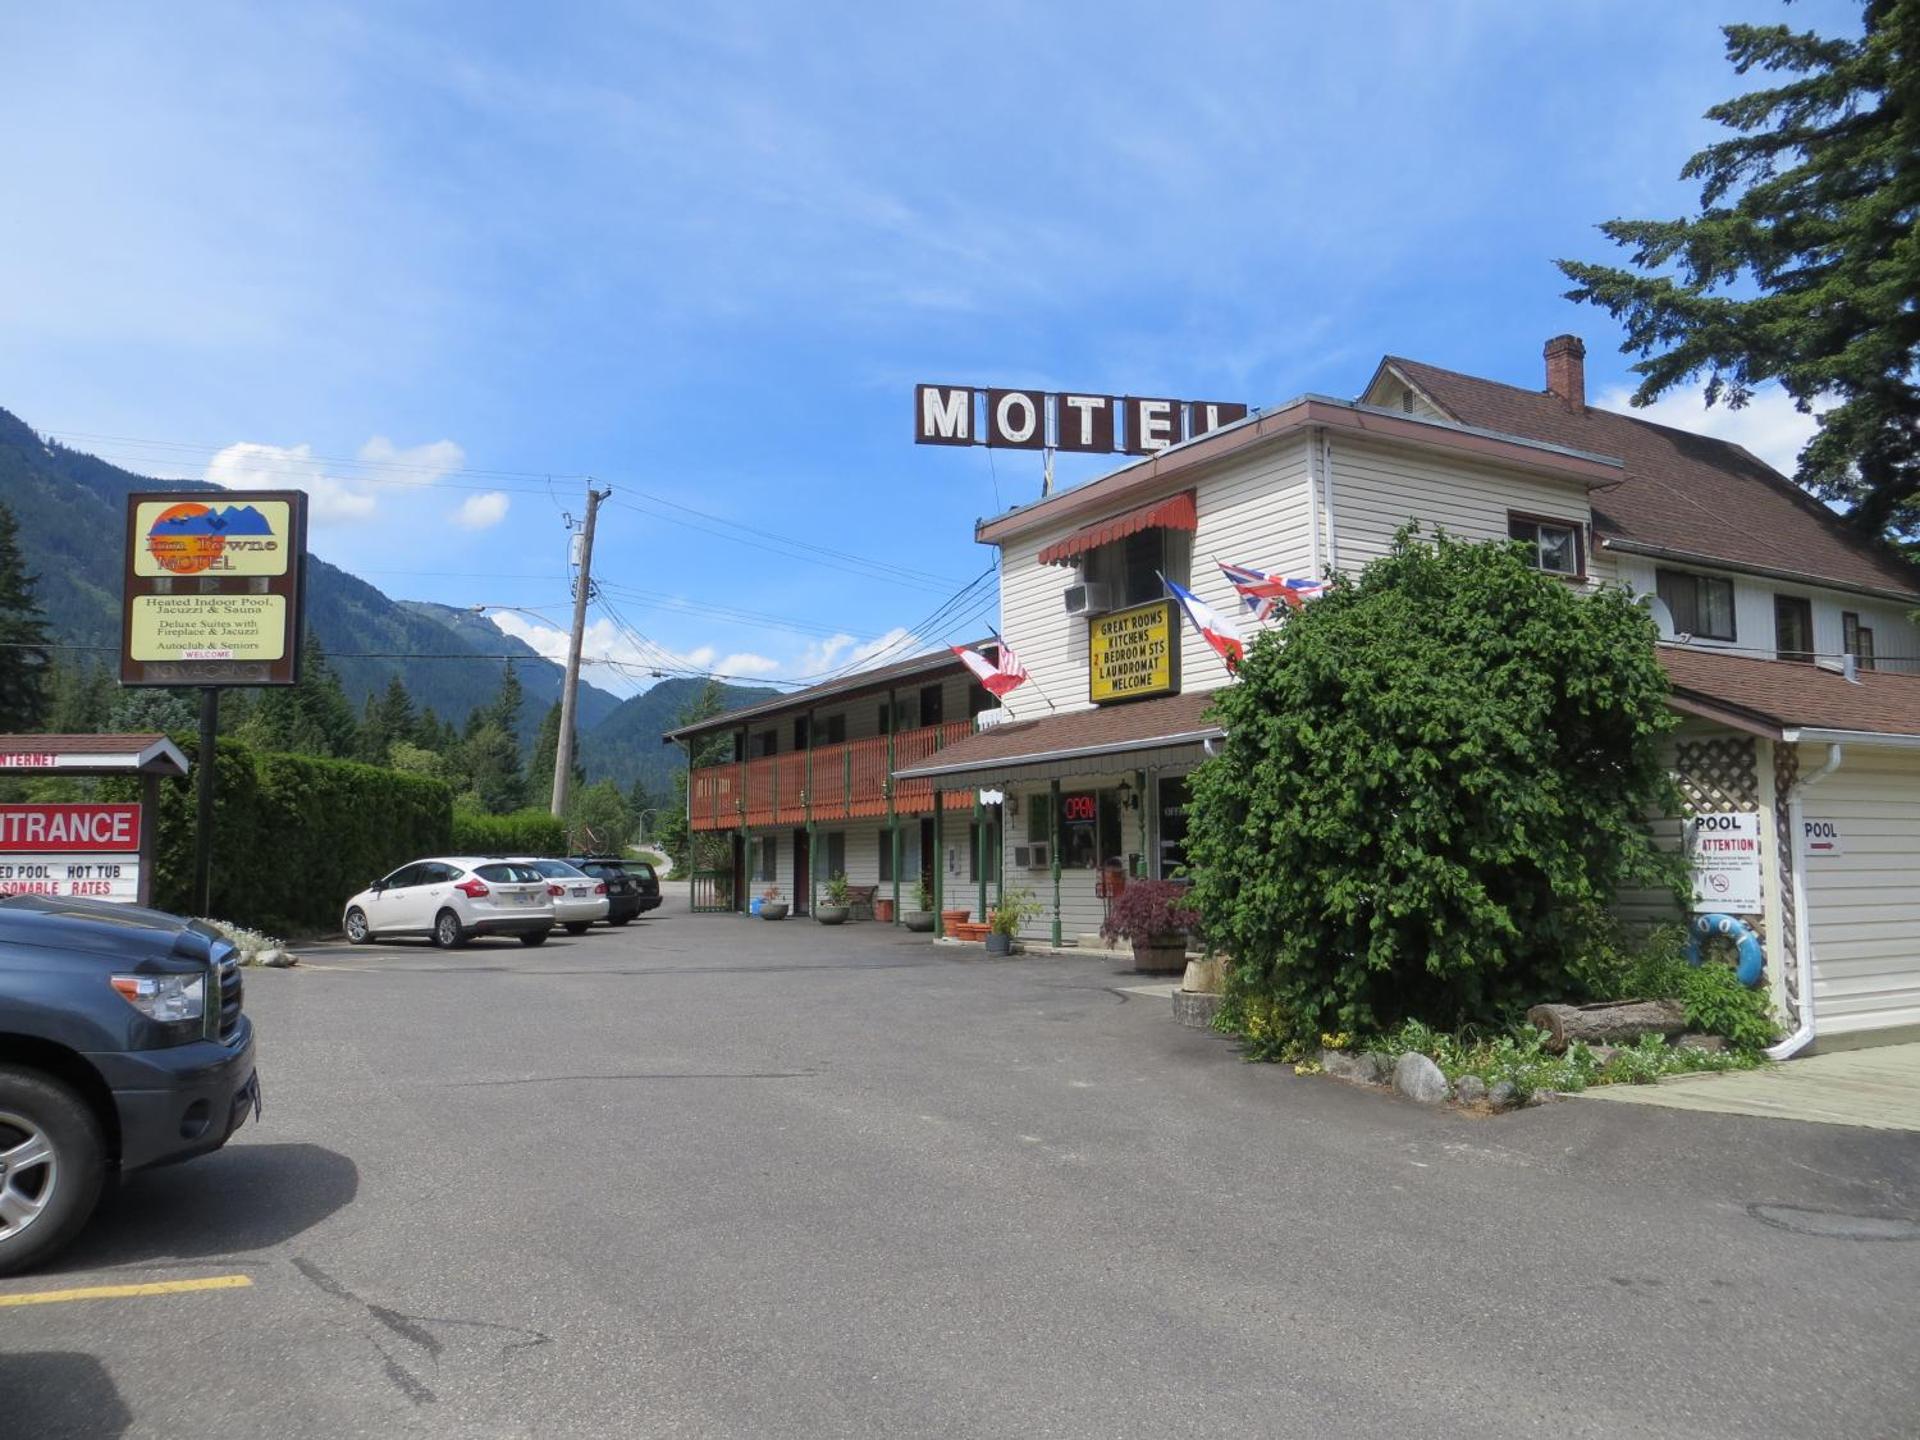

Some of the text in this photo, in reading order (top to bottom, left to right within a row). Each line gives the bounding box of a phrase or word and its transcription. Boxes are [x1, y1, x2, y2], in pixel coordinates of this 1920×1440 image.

[157, 556, 237, 570] MOTEL
[146, 598, 191, 606] Heated
[195, 598, 236, 606] Indoor
[156, 606, 262, 614] Jacuzzi & Sauna
[159, 620, 257, 628] Deluxe Suites with
[1101, 610, 1162, 636] GREAT ROOMS
[157, 628, 259, 637] Fireplace & Jacuzzi
[1108, 629, 1149, 648] KITCHENS
[157, 642, 259, 650] Autoclub & Seniors
[1093, 641, 1165, 666] 2 BEDROOM STS
[1099, 657, 1158, 679] LAUNDROMAT
[1111, 673, 1152, 691] WELCOME
[1066, 796, 1096, 819] OPEN
[0, 812, 132, 843] TRANCE
[1696, 816, 1741, 831] POOL
[1804, 822, 1838, 838] POOL
[1702, 839, 1754, 851] ATTENTION
[18, 865, 51, 878] POOL
[67, 865, 92, 878] HOT
[97, 865, 121, 878] TUB
[72, 881, 111, 895] RATES
